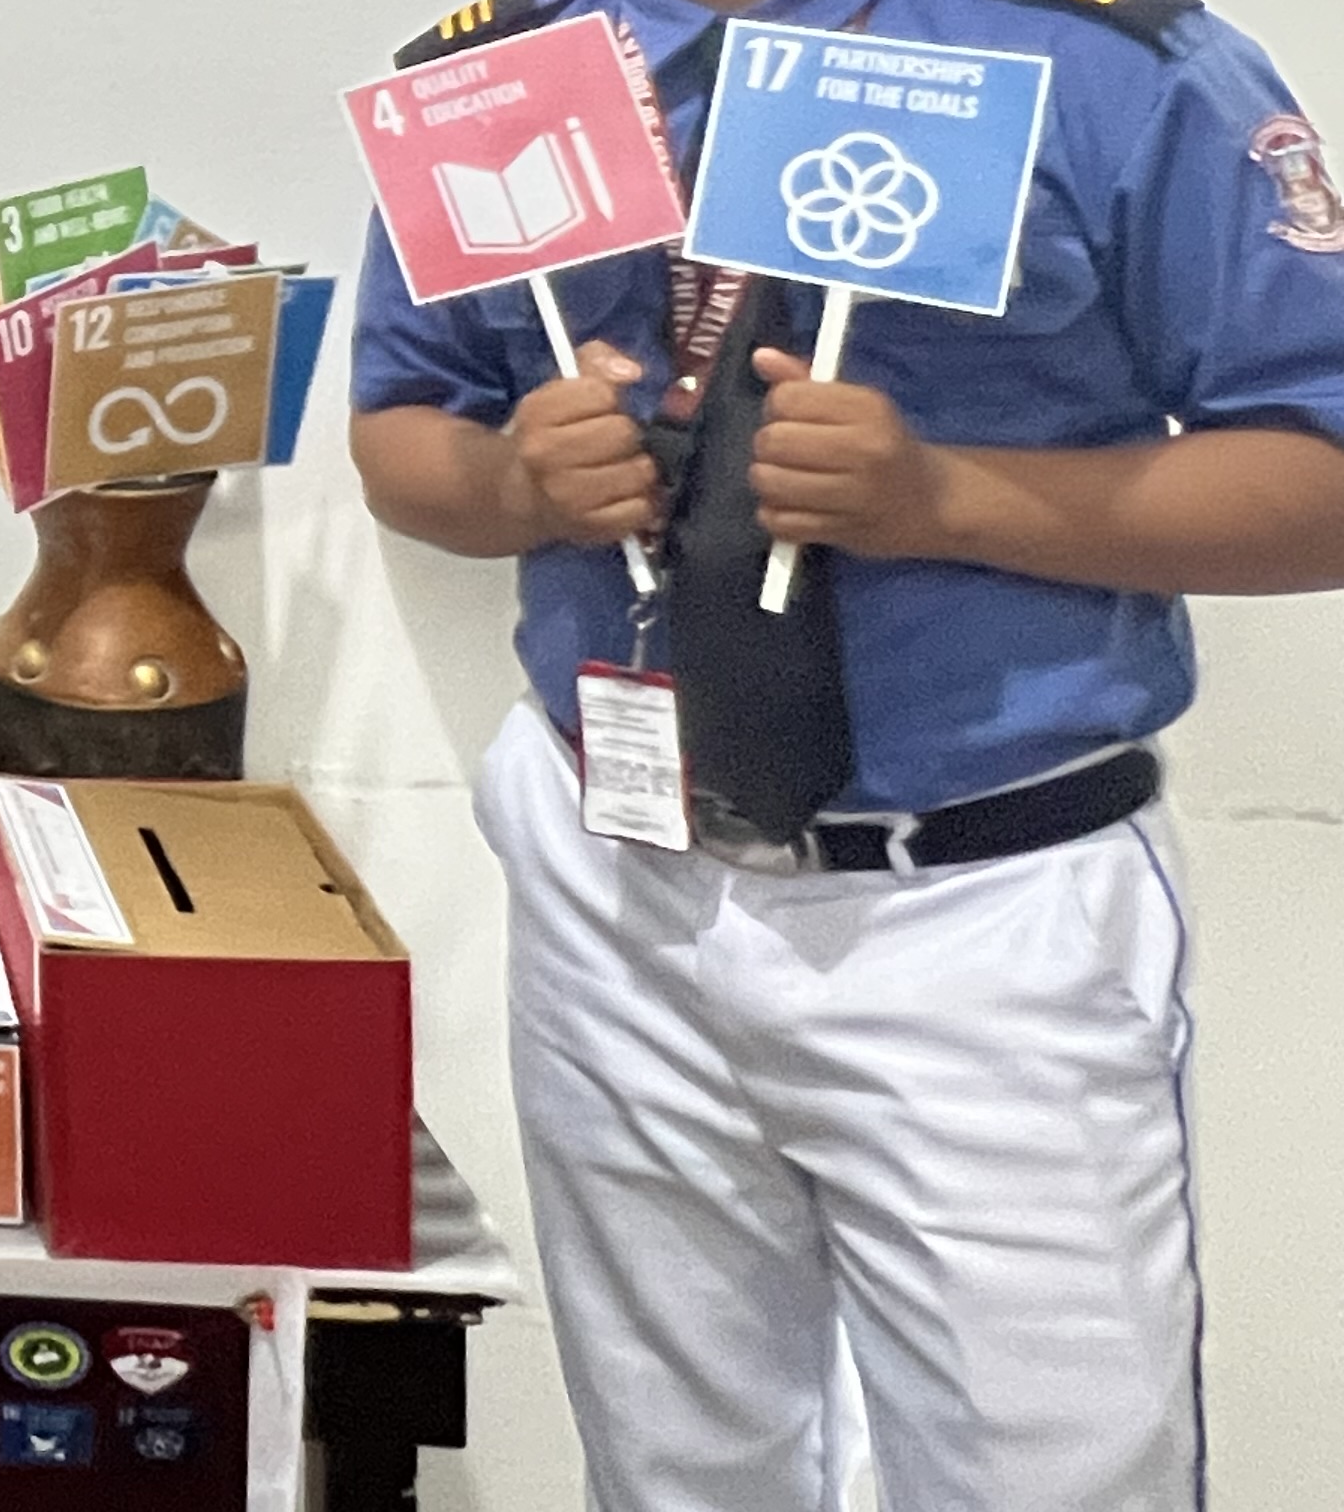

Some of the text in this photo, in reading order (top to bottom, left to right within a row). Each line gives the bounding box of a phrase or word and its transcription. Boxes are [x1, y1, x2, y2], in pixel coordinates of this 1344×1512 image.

[745, 37, 803, 92] 17
[823, 45, 986, 87] PARTNERSHIPS
[373, 89, 405, 136] 4
[816, 76, 980, 119] FOR THE GOALS
[1, 206, 23, 253] 3
[68, 304, 113, 353] 12
